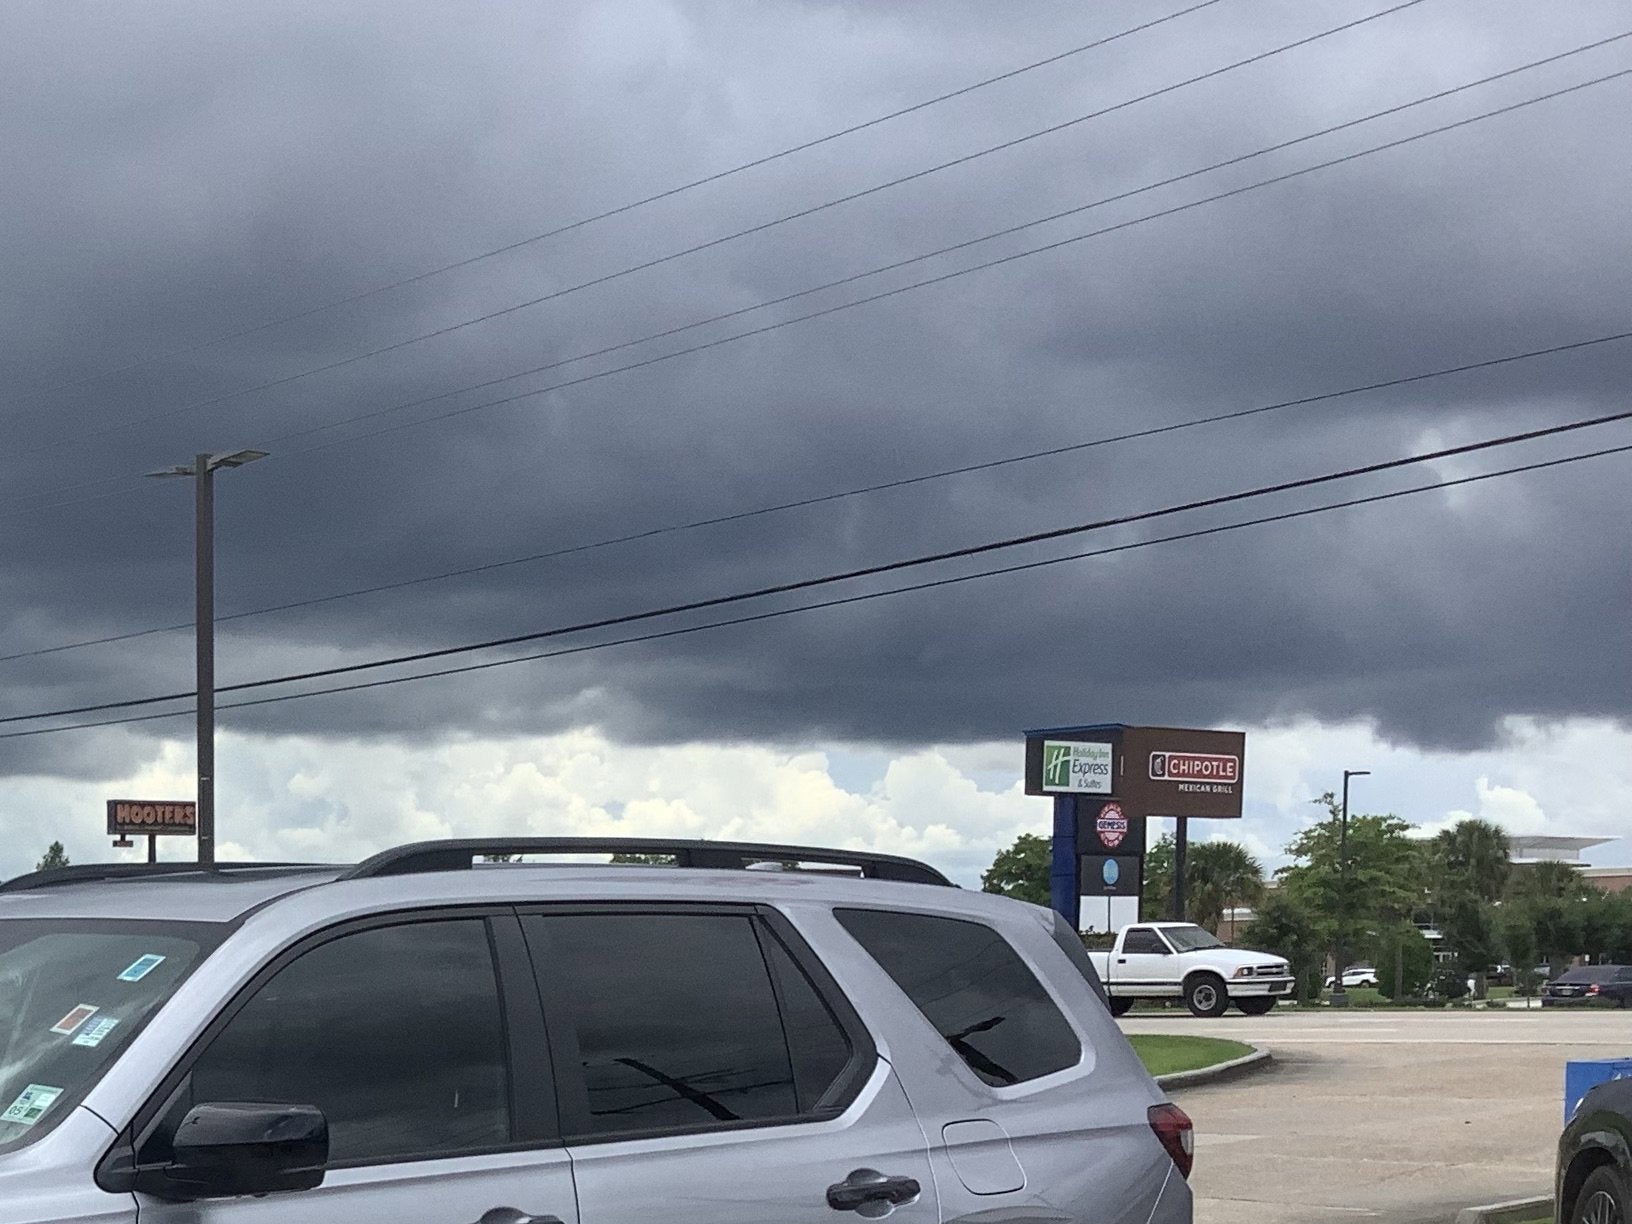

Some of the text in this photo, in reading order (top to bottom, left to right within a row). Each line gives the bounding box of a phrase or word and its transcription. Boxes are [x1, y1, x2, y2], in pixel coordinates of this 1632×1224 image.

[1071, 758, 1109, 777] Express
[1169, 759, 1235, 776] CHIPOTLE
[1178, 783, 1233, 794] MEXICAN GRILL
[116, 803, 195, 825] HOOTERS
